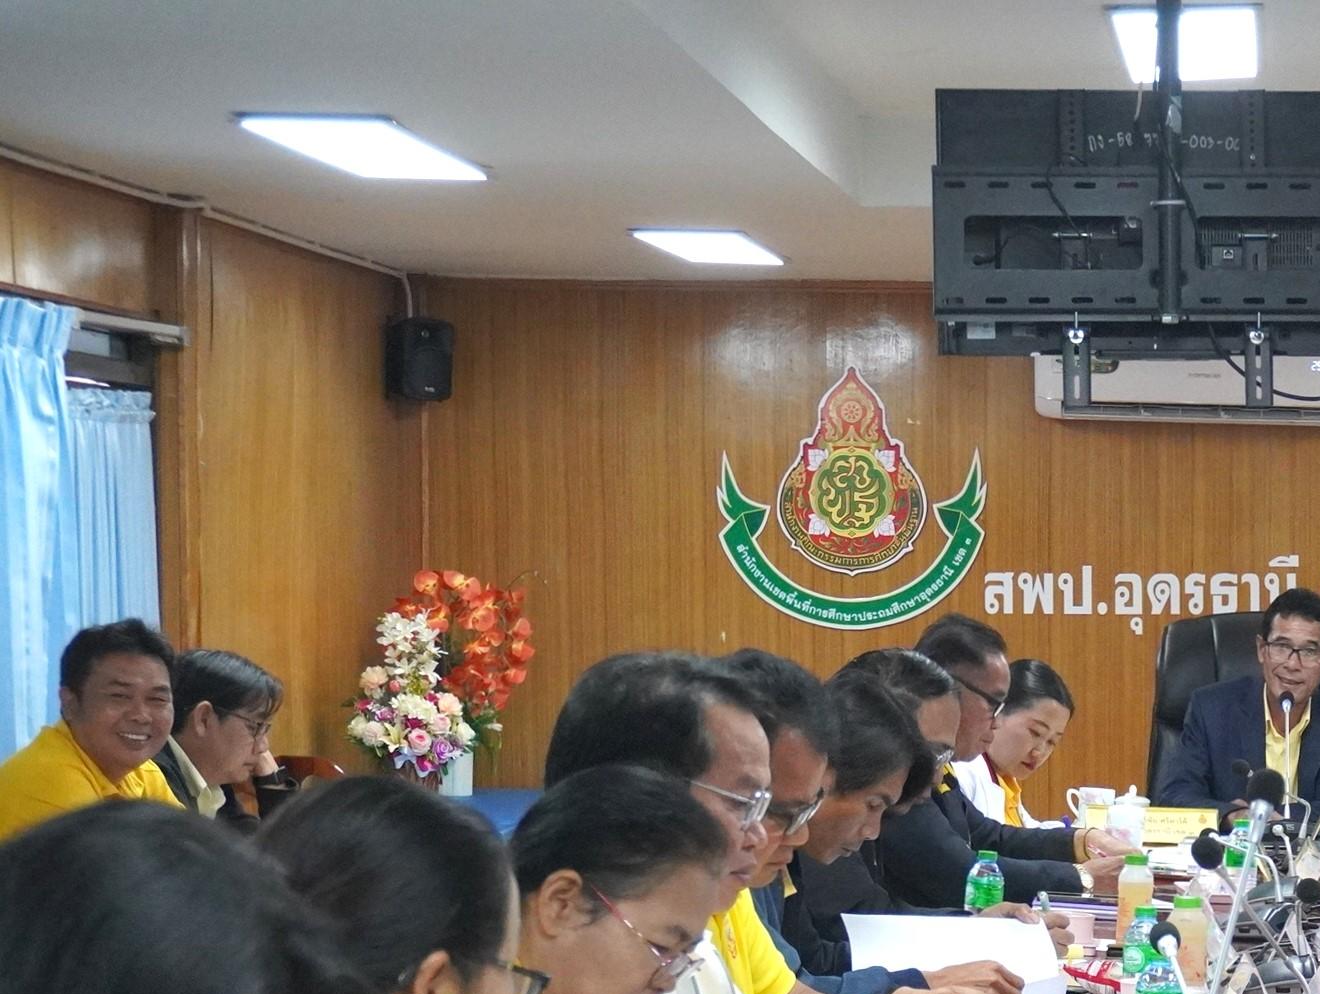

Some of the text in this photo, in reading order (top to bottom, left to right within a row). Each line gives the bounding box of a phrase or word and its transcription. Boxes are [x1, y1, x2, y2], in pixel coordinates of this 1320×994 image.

[952, 547, 967, 567] เขต
[984, 554, 1300, 635] สพป.อุดรธานี
